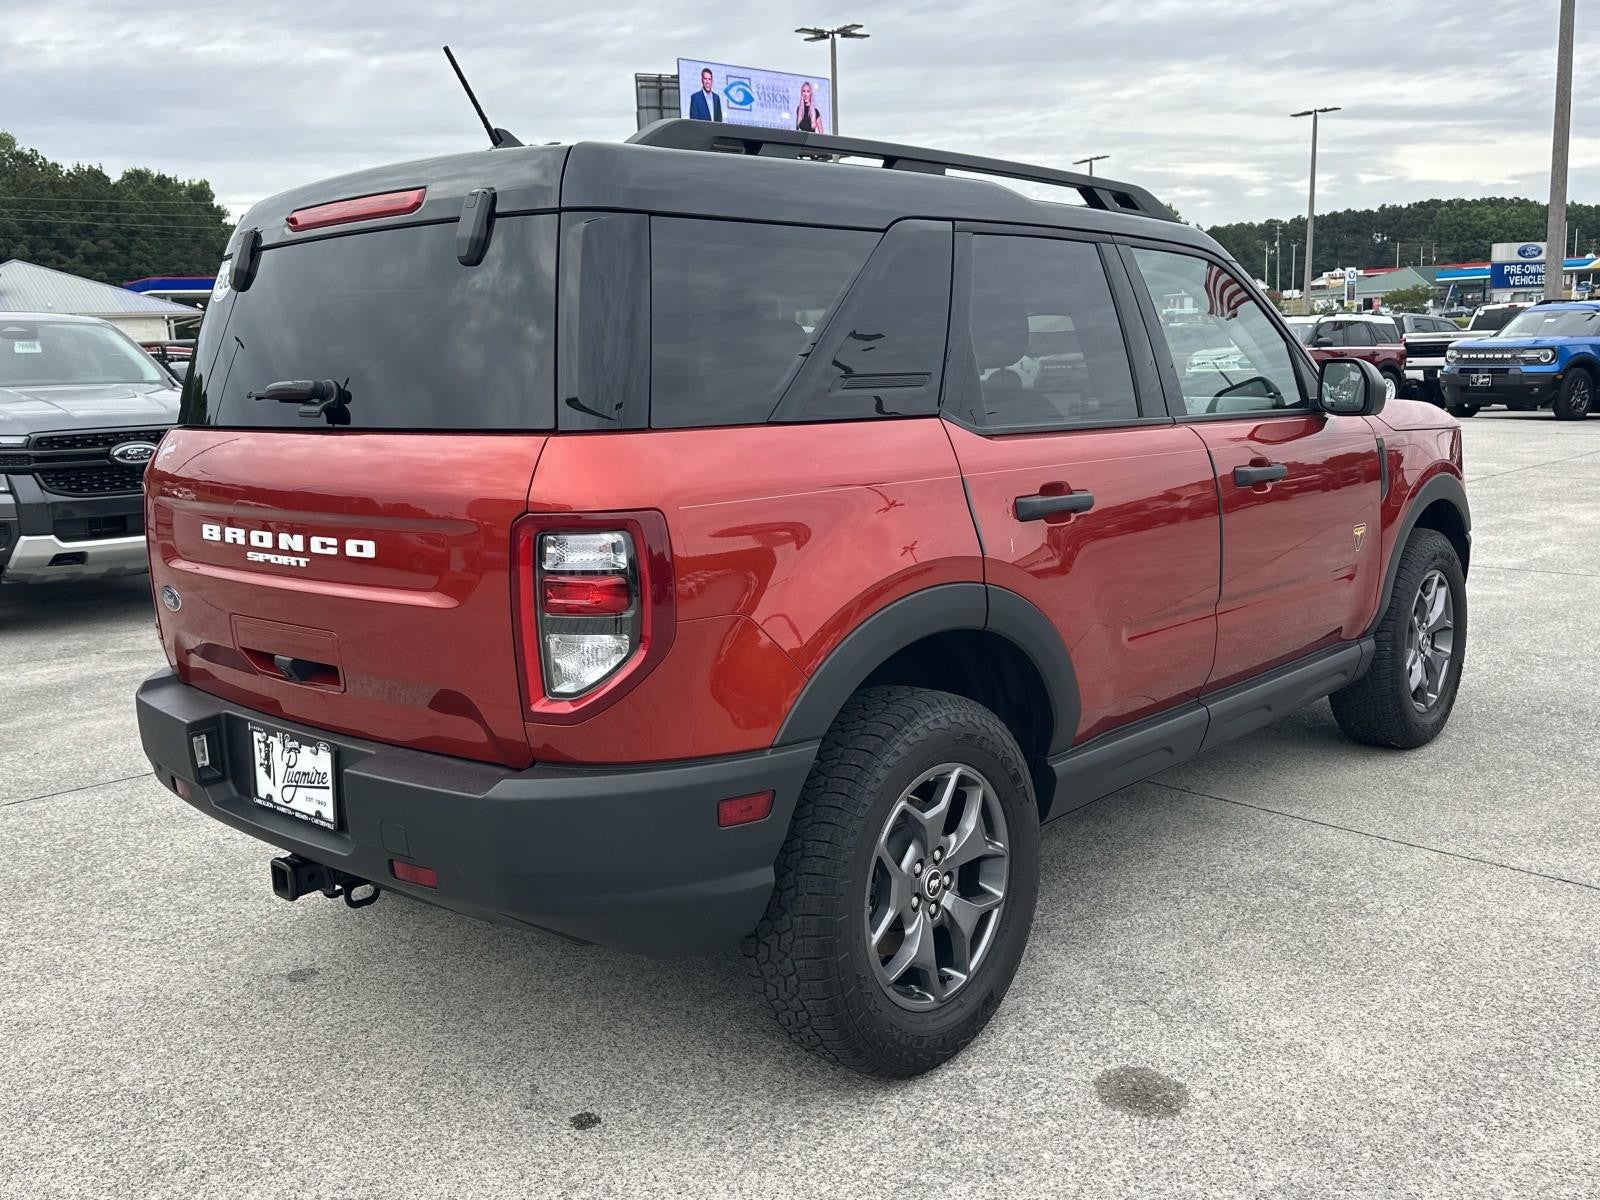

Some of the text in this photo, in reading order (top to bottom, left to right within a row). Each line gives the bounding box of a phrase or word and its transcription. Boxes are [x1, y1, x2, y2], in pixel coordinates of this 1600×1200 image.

[756, 91, 790, 104] VISION
[1504, 264, 1546, 275] PRE-OWNE
[1509, 275, 1546, 286] VEHICLES
[201, 523, 376, 559] BRONCO
[246, 551, 310, 568] SPORT
[280, 748, 330, 804] Pugmire
